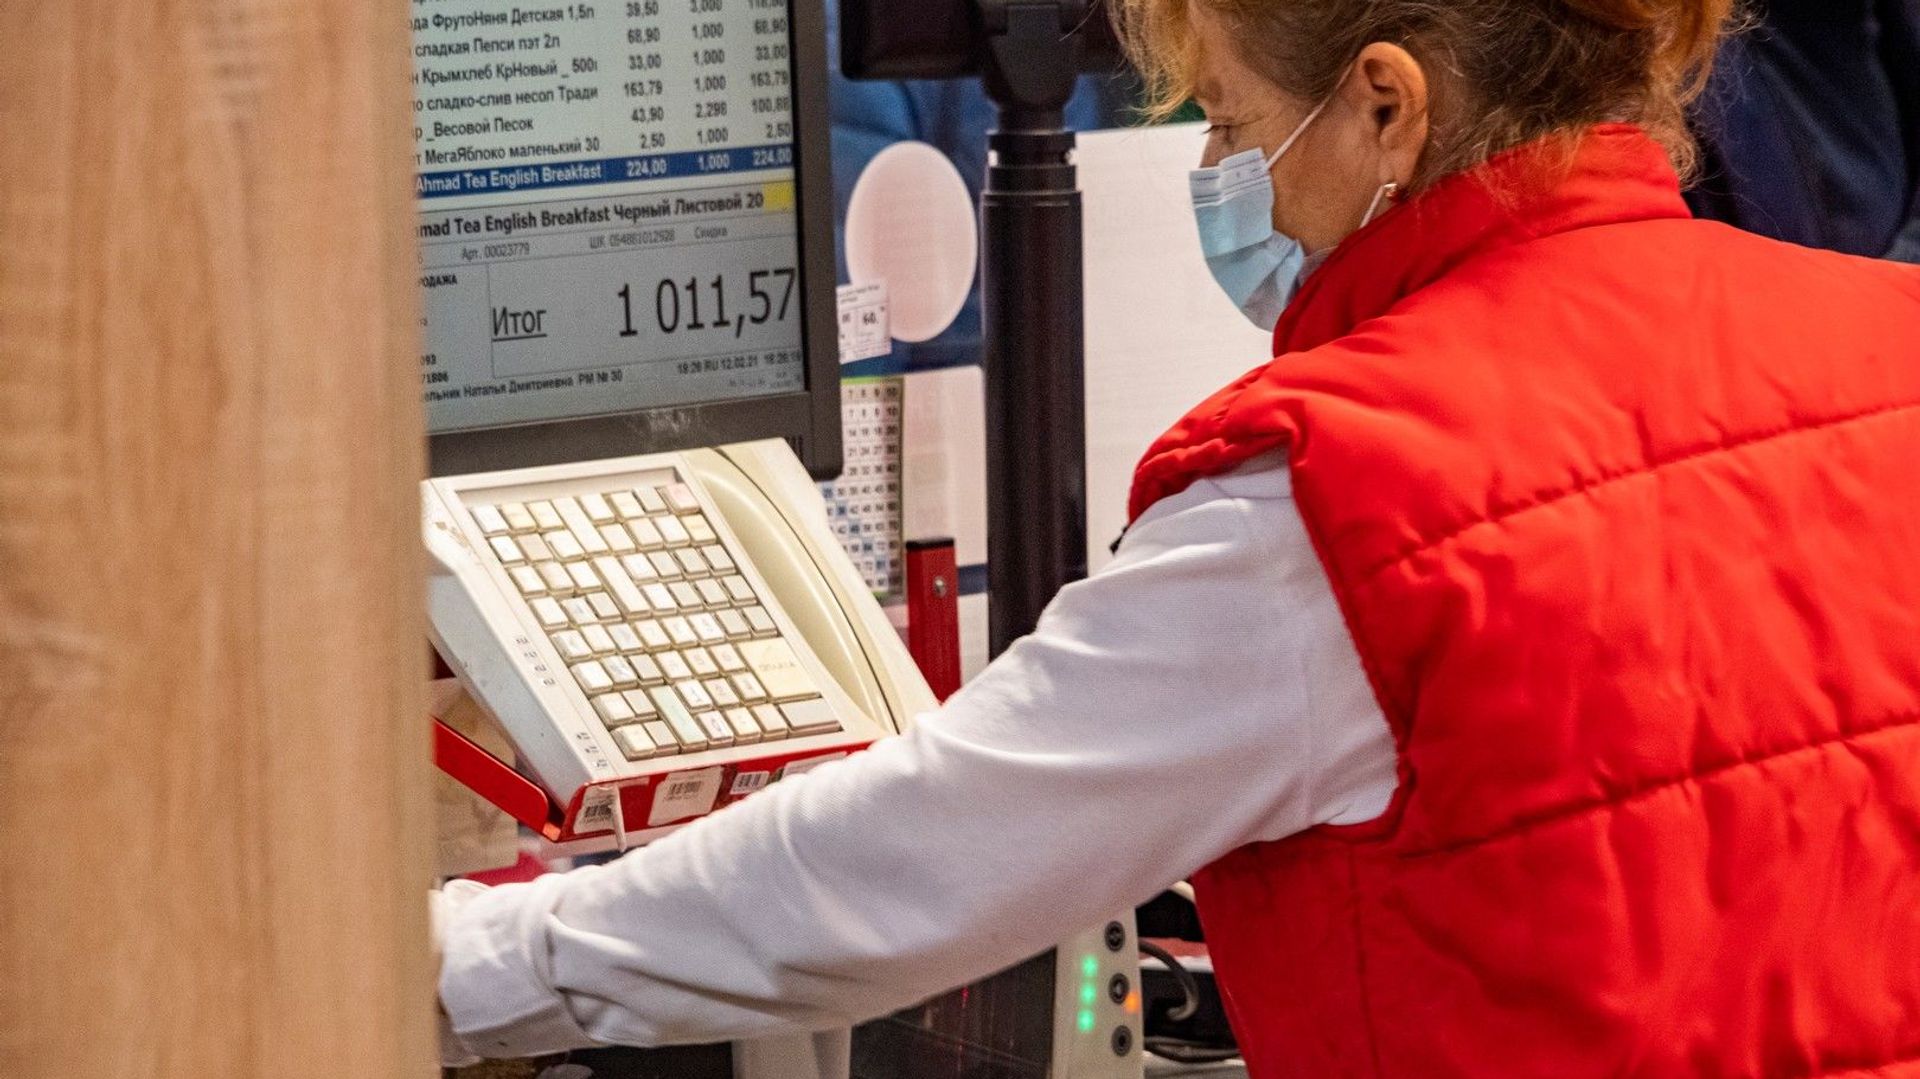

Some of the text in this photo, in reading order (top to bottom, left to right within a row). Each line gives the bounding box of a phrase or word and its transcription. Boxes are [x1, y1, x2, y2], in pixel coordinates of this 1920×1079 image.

[512, 8, 564, 26] Детская
[415, 40, 470, 56] сладкая
[474, 37, 515, 53] Пепси
[519, 36, 540, 50] пэт
[544, 34, 560, 48] 2л
[691, 22, 724, 40] 1,000
[422, 64, 493, 86] Крымхлеб
[496, 60, 558, 81] КрНовый
[629, 54, 662, 70] 33,00
[694, 49, 725, 66] 1,000
[558, 86, 598, 103] Тради
[694, 76, 726, 93] 1,000
[494, 117, 534, 132] Песок
[426, 146, 505, 164] МегаЯблоко
[510, 139, 581, 158] маленький
[586, 137, 600, 152] 30
[698, 128, 728, 146] 1,000
[416, 150, 791, 193] Ahmad Tea English Breakfast 224,00 1,000 224,00
[454, 218, 480, 234] Tea
[486, 213, 537, 234] English
[541, 206, 610, 228] Breakfast
[614, 198, 671, 224] Черный
[674, 193, 742, 214] Листовой
[747, 193, 764, 209] 20
[492, 306, 546, 338] Итог
